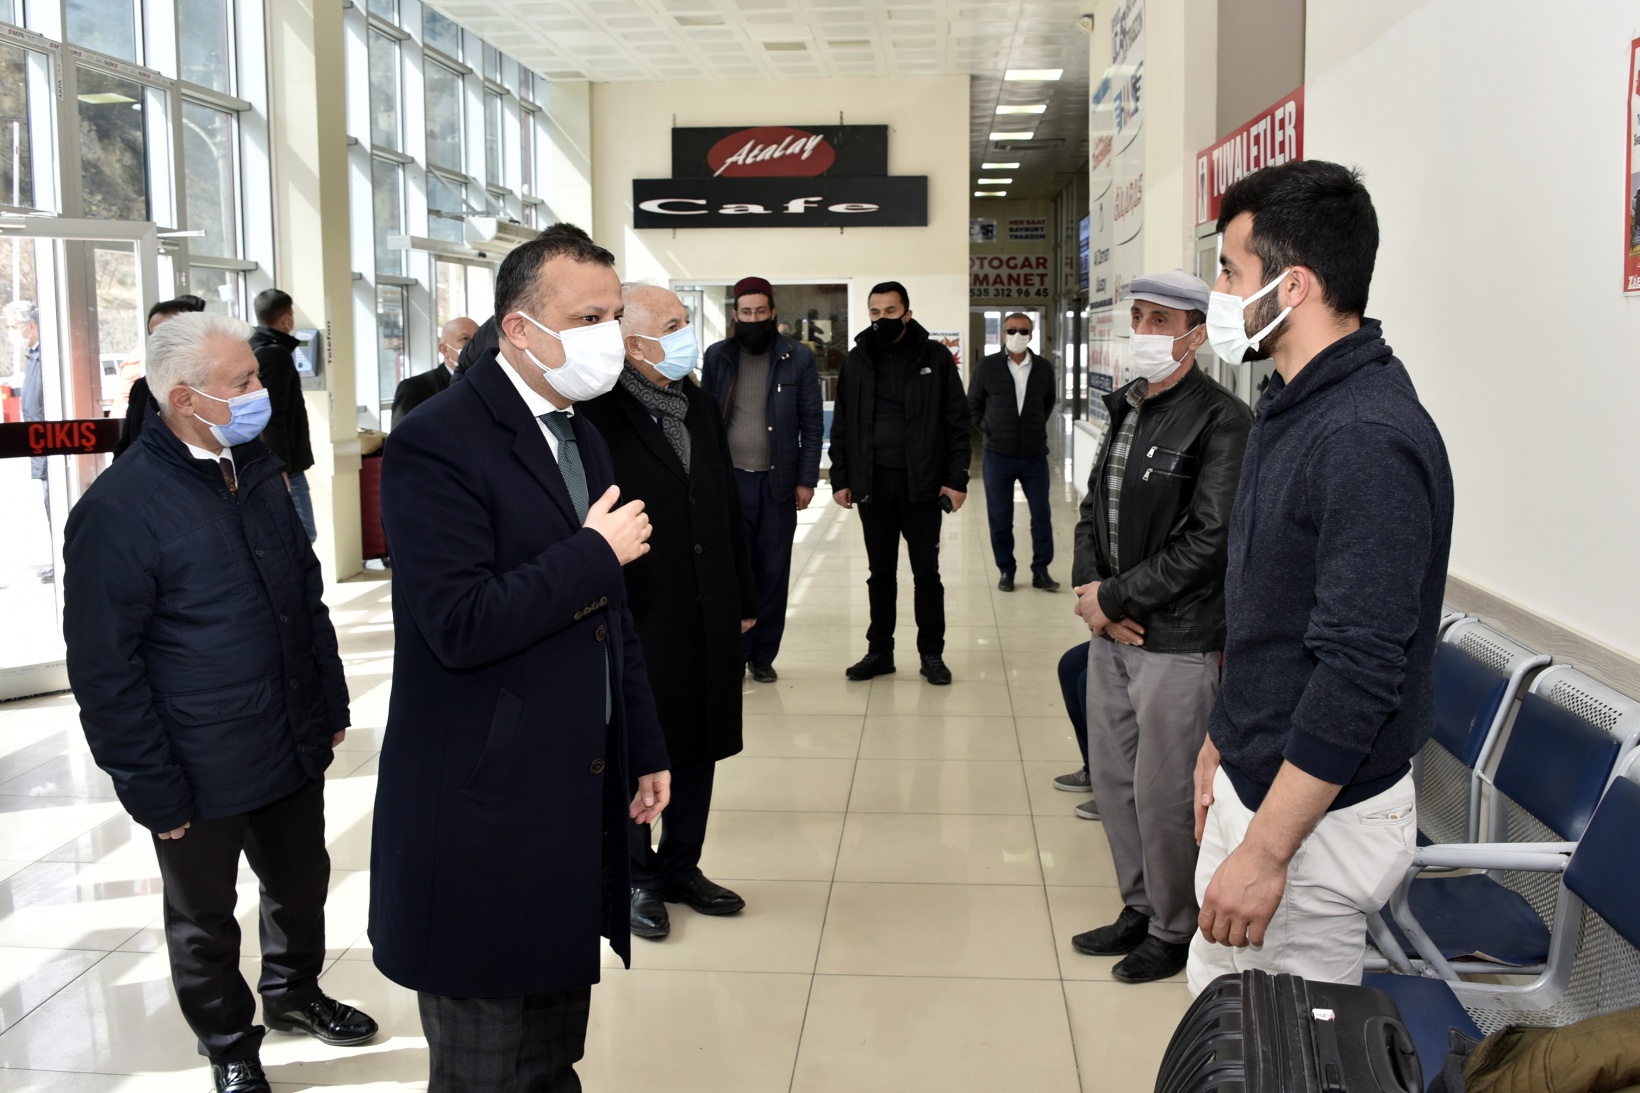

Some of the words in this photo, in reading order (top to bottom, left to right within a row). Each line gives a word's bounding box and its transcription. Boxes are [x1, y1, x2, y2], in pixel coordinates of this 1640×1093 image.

[713, 134, 824, 178] Atalay
[1212, 100, 1297, 198] TUVALETLER
[638, 196, 880, 215] Cafe
[970, 273, 1049, 287] MANET
[993, 288, 1012, 298] 312
[1016, 288, 1031, 298] 96
[1034, 288, 1049, 298] 45
[28, 421, 97, 454] ÇIKIŞ
